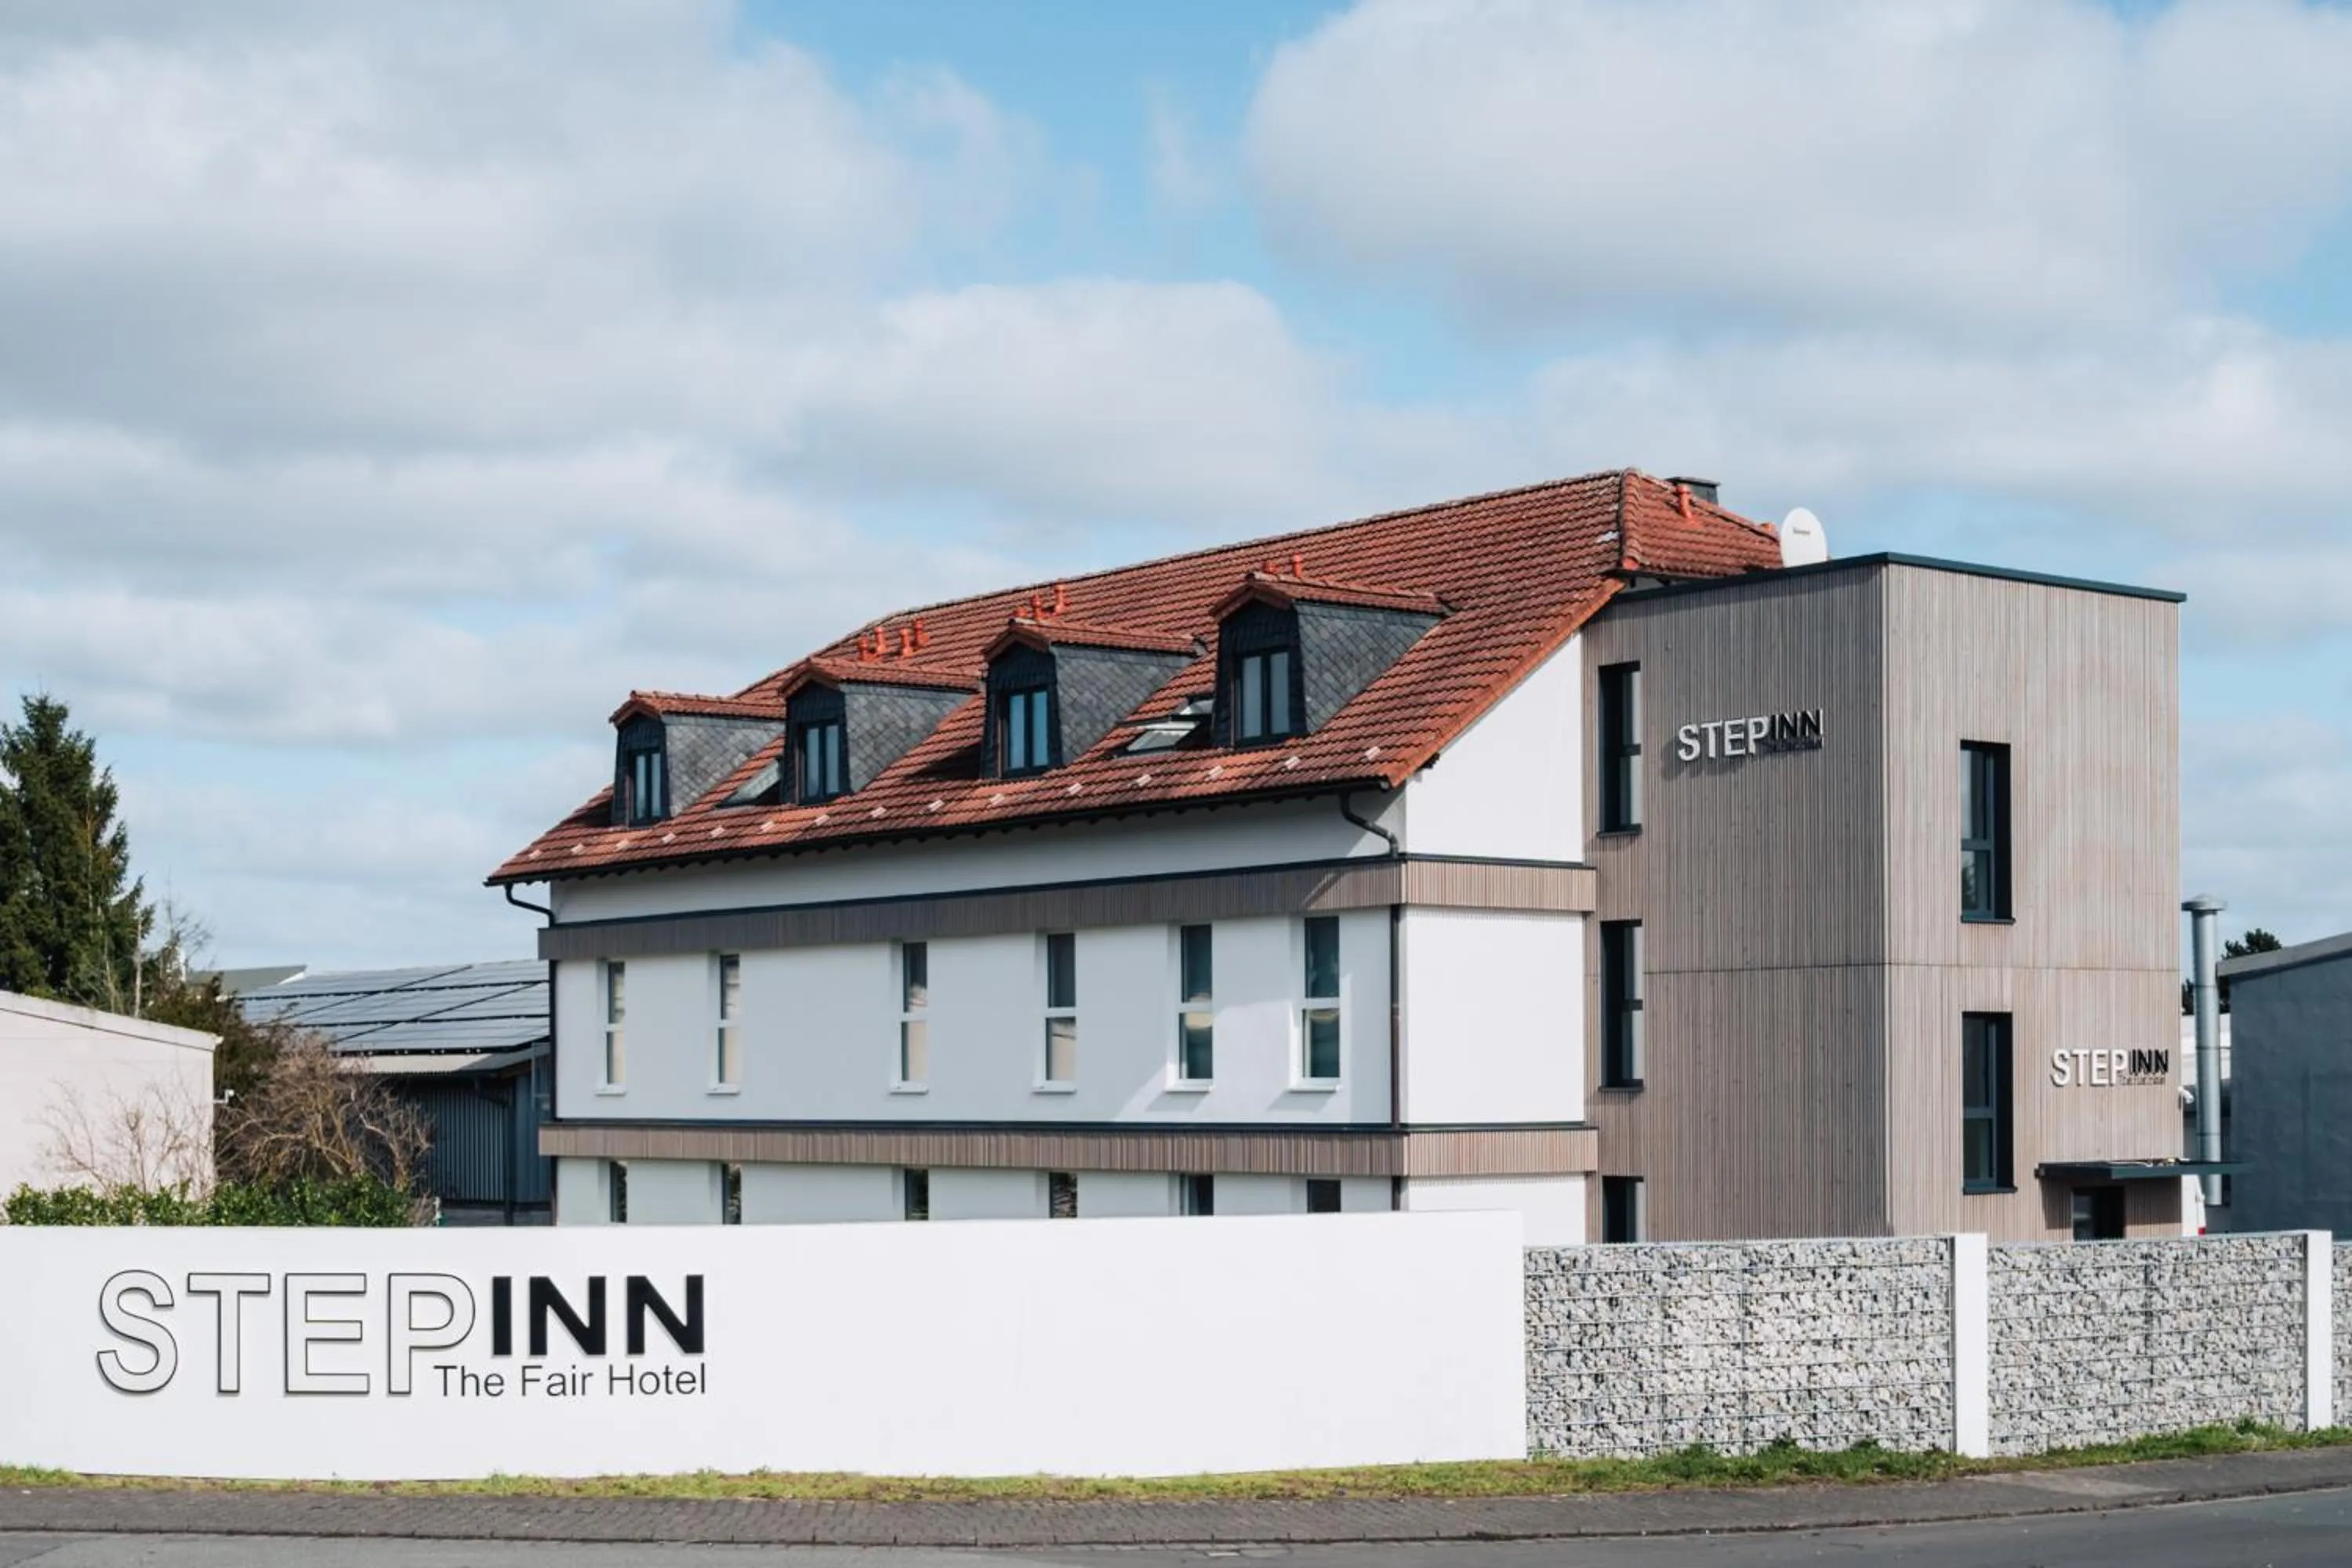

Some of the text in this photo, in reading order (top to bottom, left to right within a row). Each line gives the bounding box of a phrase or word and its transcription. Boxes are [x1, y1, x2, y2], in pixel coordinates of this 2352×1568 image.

[434, 1362, 706, 1397] The Fair Hotel
